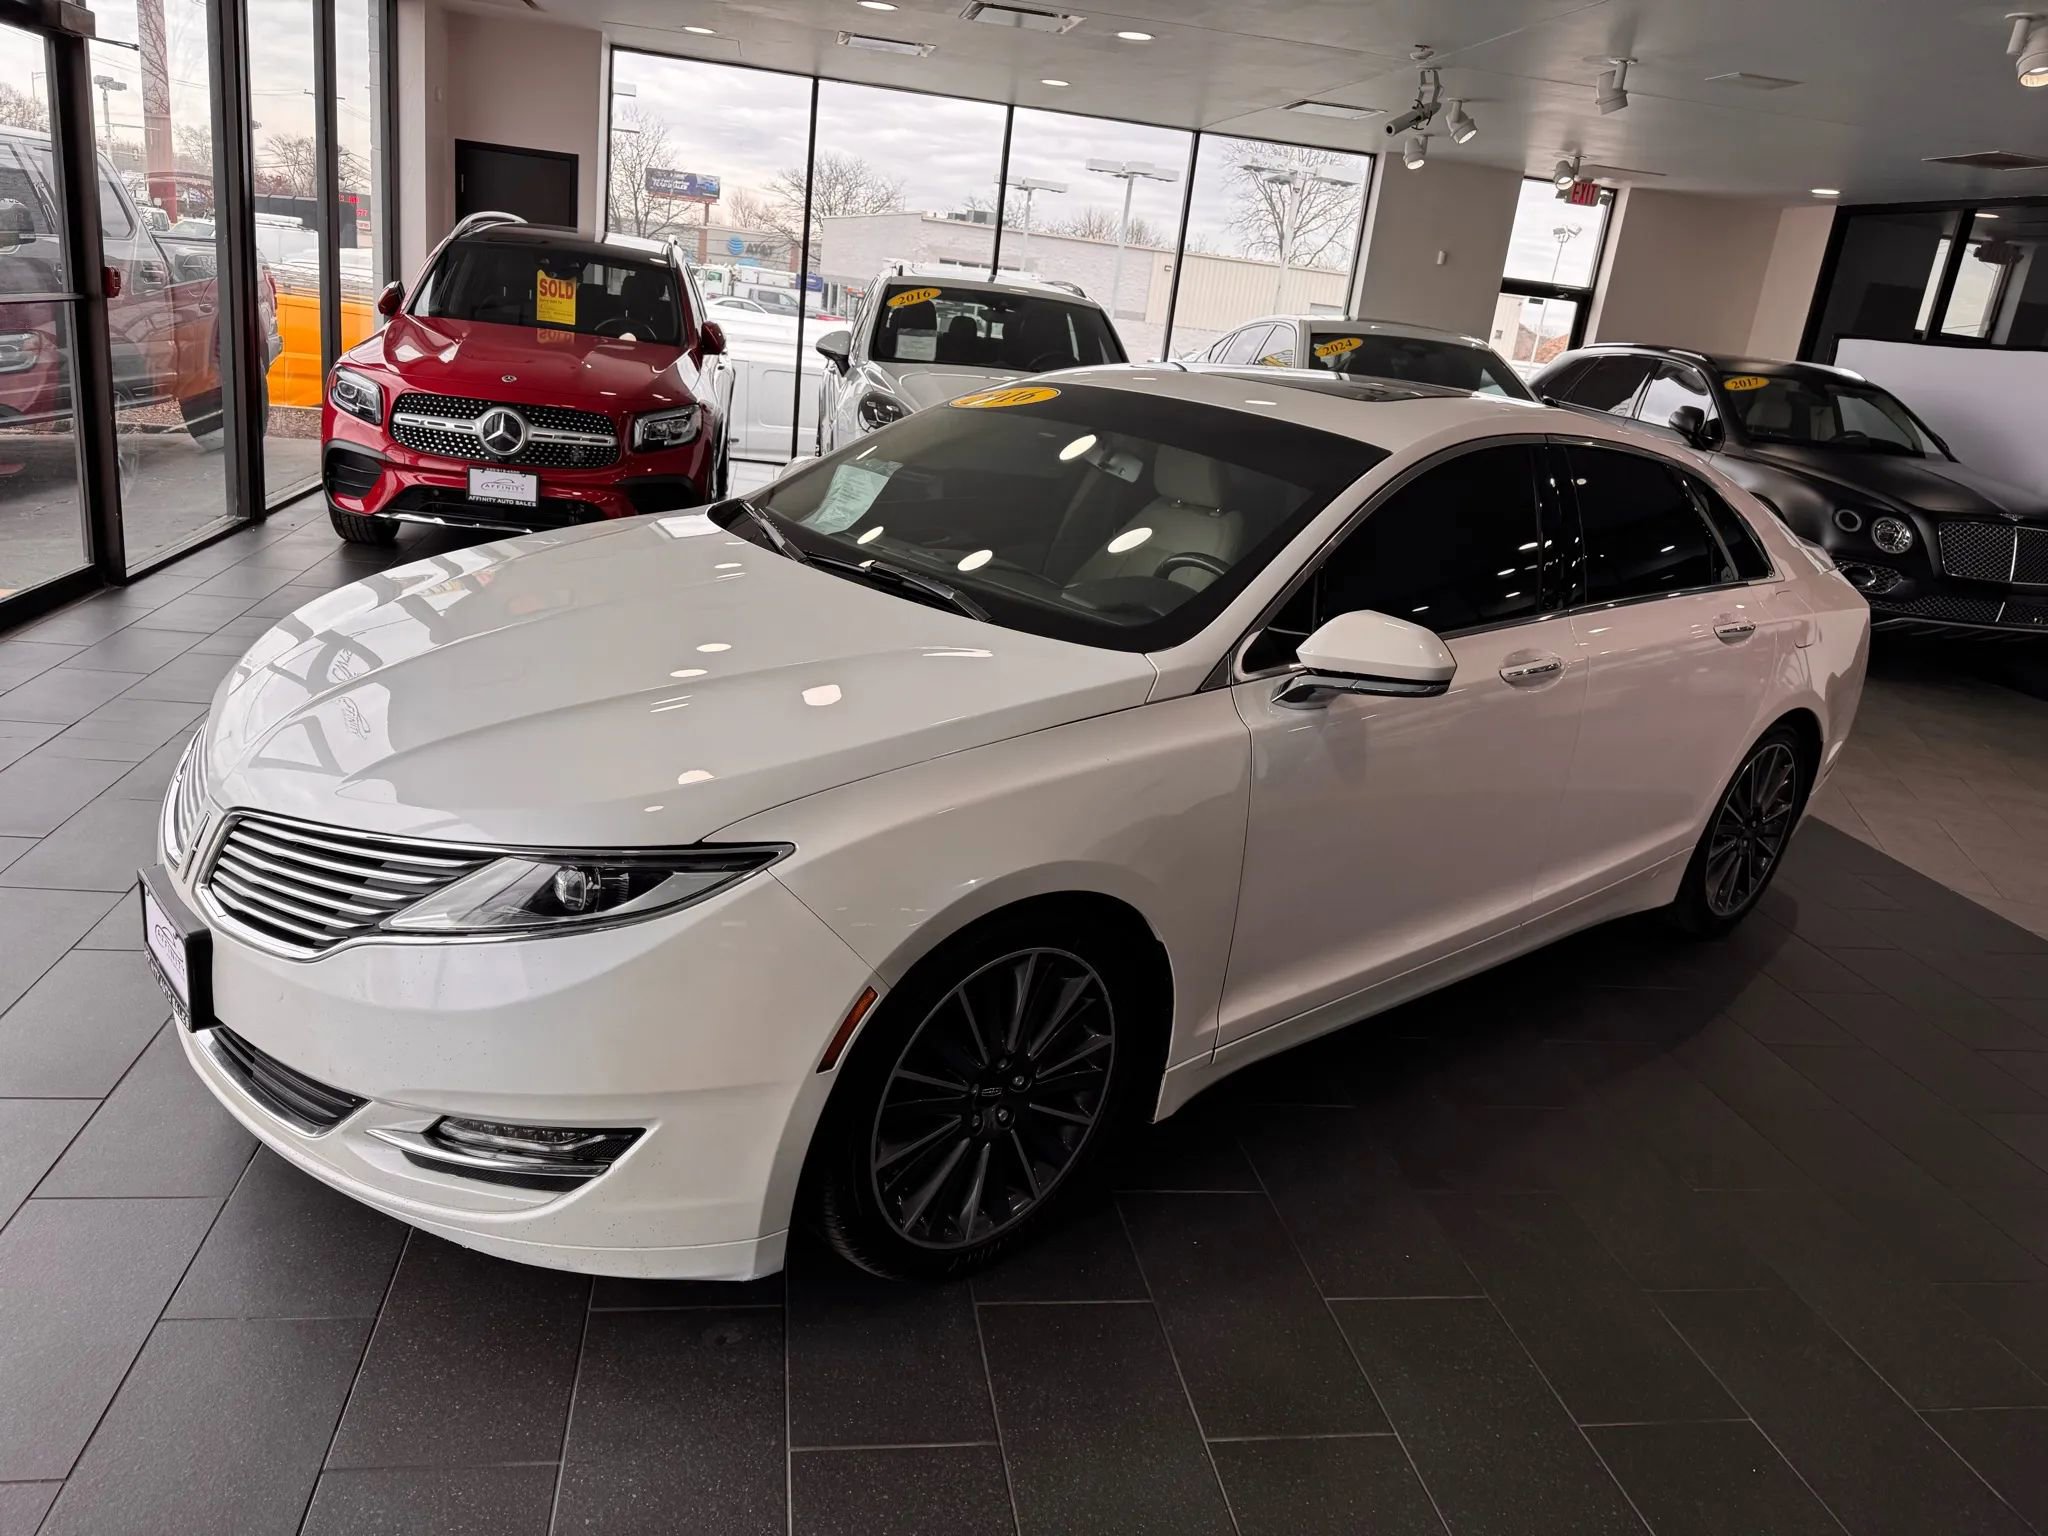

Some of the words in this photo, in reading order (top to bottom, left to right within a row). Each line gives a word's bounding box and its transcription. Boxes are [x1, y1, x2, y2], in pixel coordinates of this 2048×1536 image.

[1571, 183, 1598, 205] EXIT
[745, 243, 775, 257] AT&T
[539, 278, 574, 299] SOLD
[898, 290, 931, 304] 2016
[1324, 339, 1353, 355] 2024
[1731, 377, 1759, 389] 2017
[485, 483, 525, 492] AFFINITY
[468, 495, 497, 505] AFFINITY
[497, 498, 514, 506] AUTO
